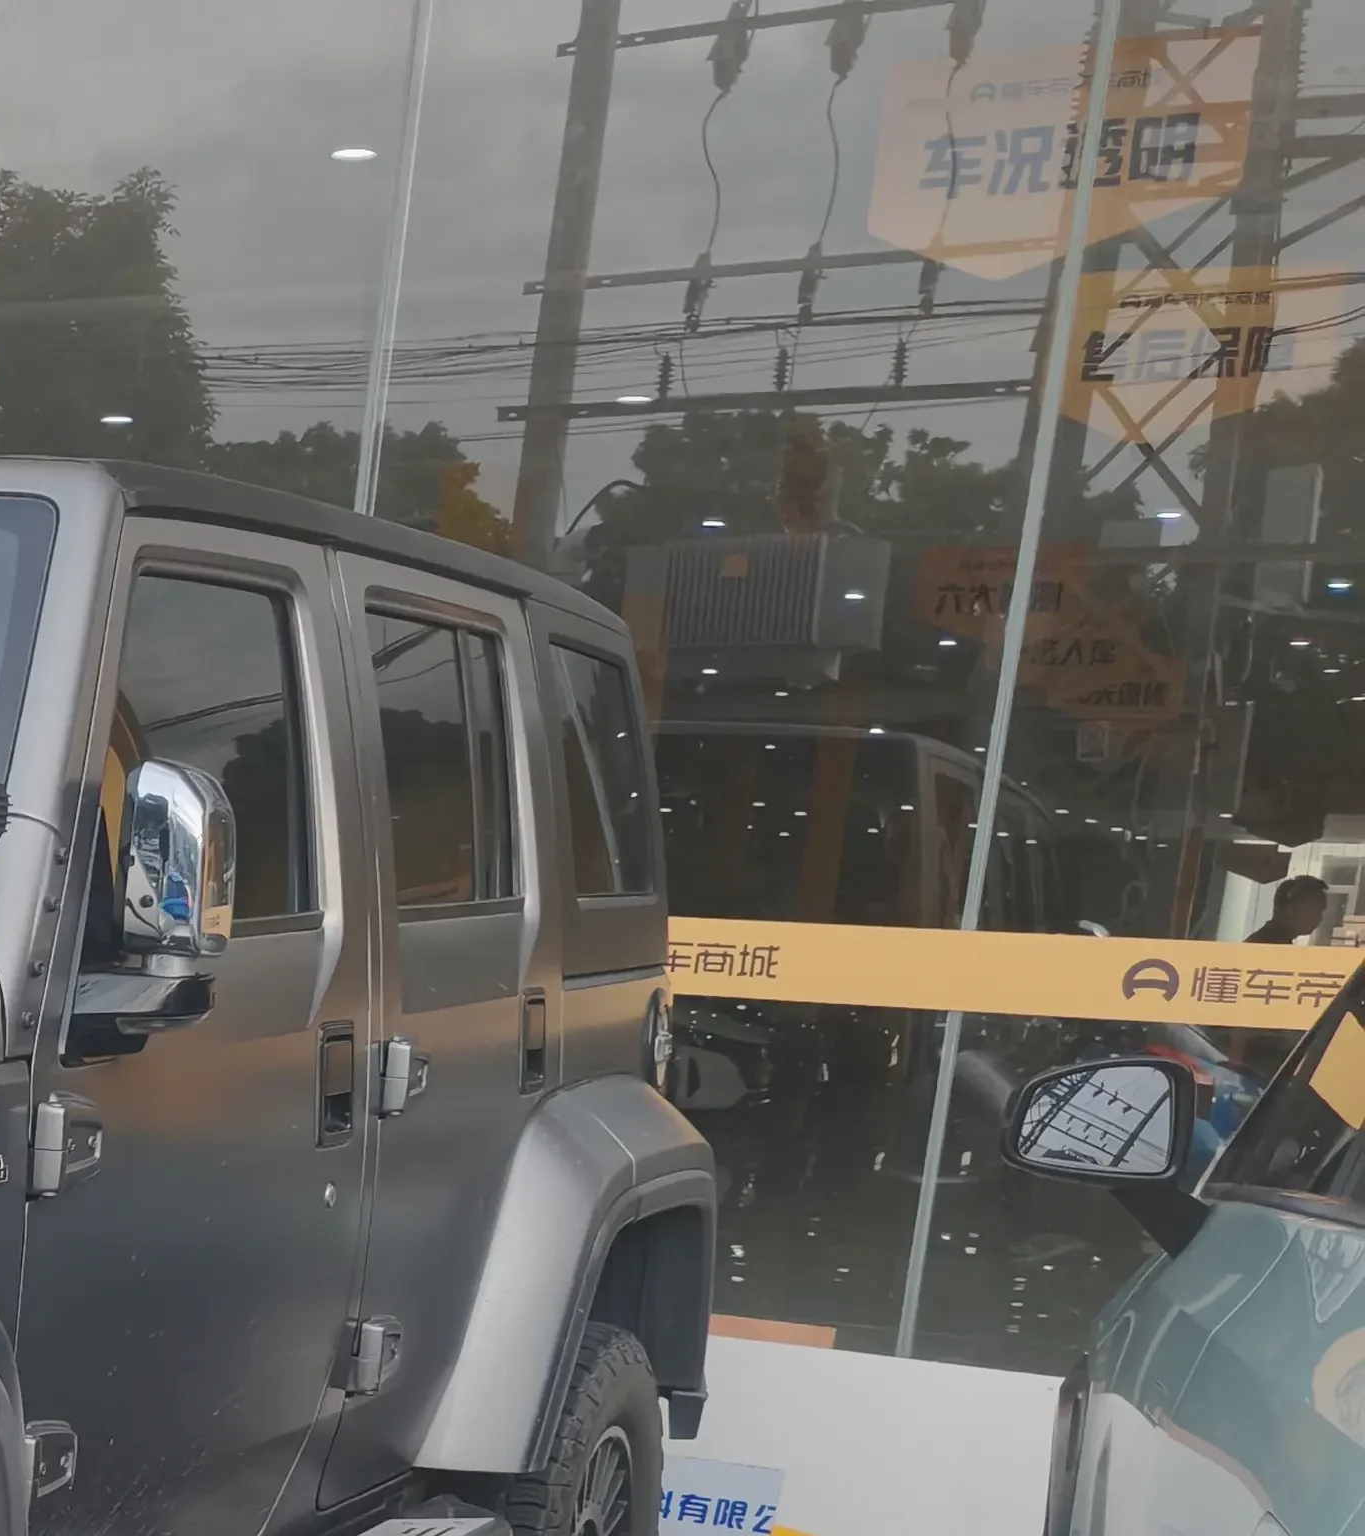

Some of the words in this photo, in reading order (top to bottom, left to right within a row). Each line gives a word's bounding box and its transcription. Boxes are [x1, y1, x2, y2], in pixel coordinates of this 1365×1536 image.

[919, 112, 1201, 199] 车况透明
[1081, 325, 1297, 383] 售后保障
[1190, 966, 1346, 1008] 懂车帝
